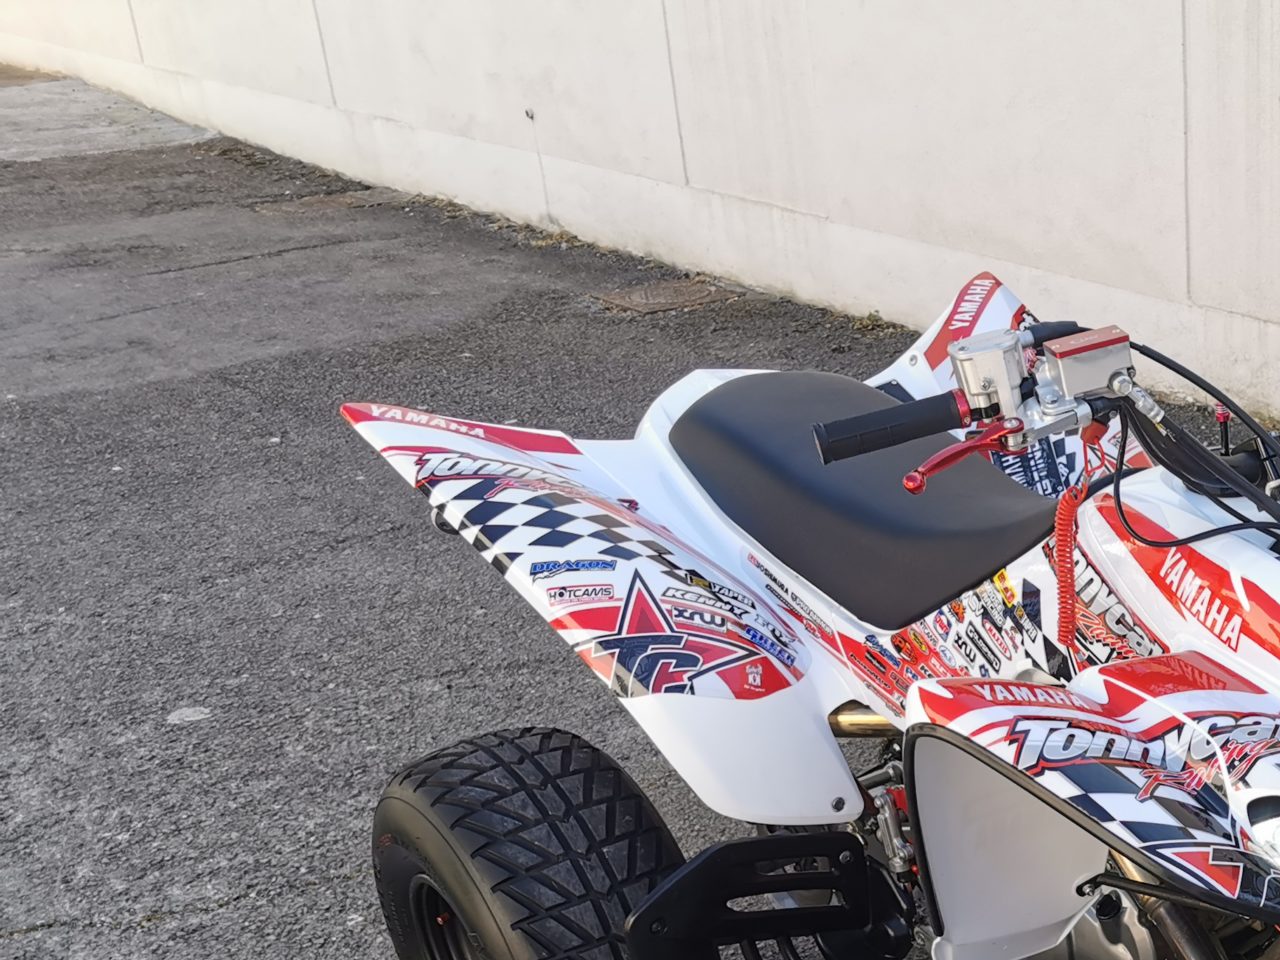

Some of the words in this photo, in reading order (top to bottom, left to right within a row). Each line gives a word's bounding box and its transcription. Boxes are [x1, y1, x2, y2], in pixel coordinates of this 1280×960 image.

[950, 279, 996, 330] YAMAHA
[369, 404, 486, 438] YAMAHA
[530, 560, 617, 576] DRAGON
[549, 586, 612, 600] HOTCAMS
[661, 587, 751, 620] KENNY
[1158, 546, 1244, 653] YAMAHA
[973, 683, 1092, 711] YAMAHA
